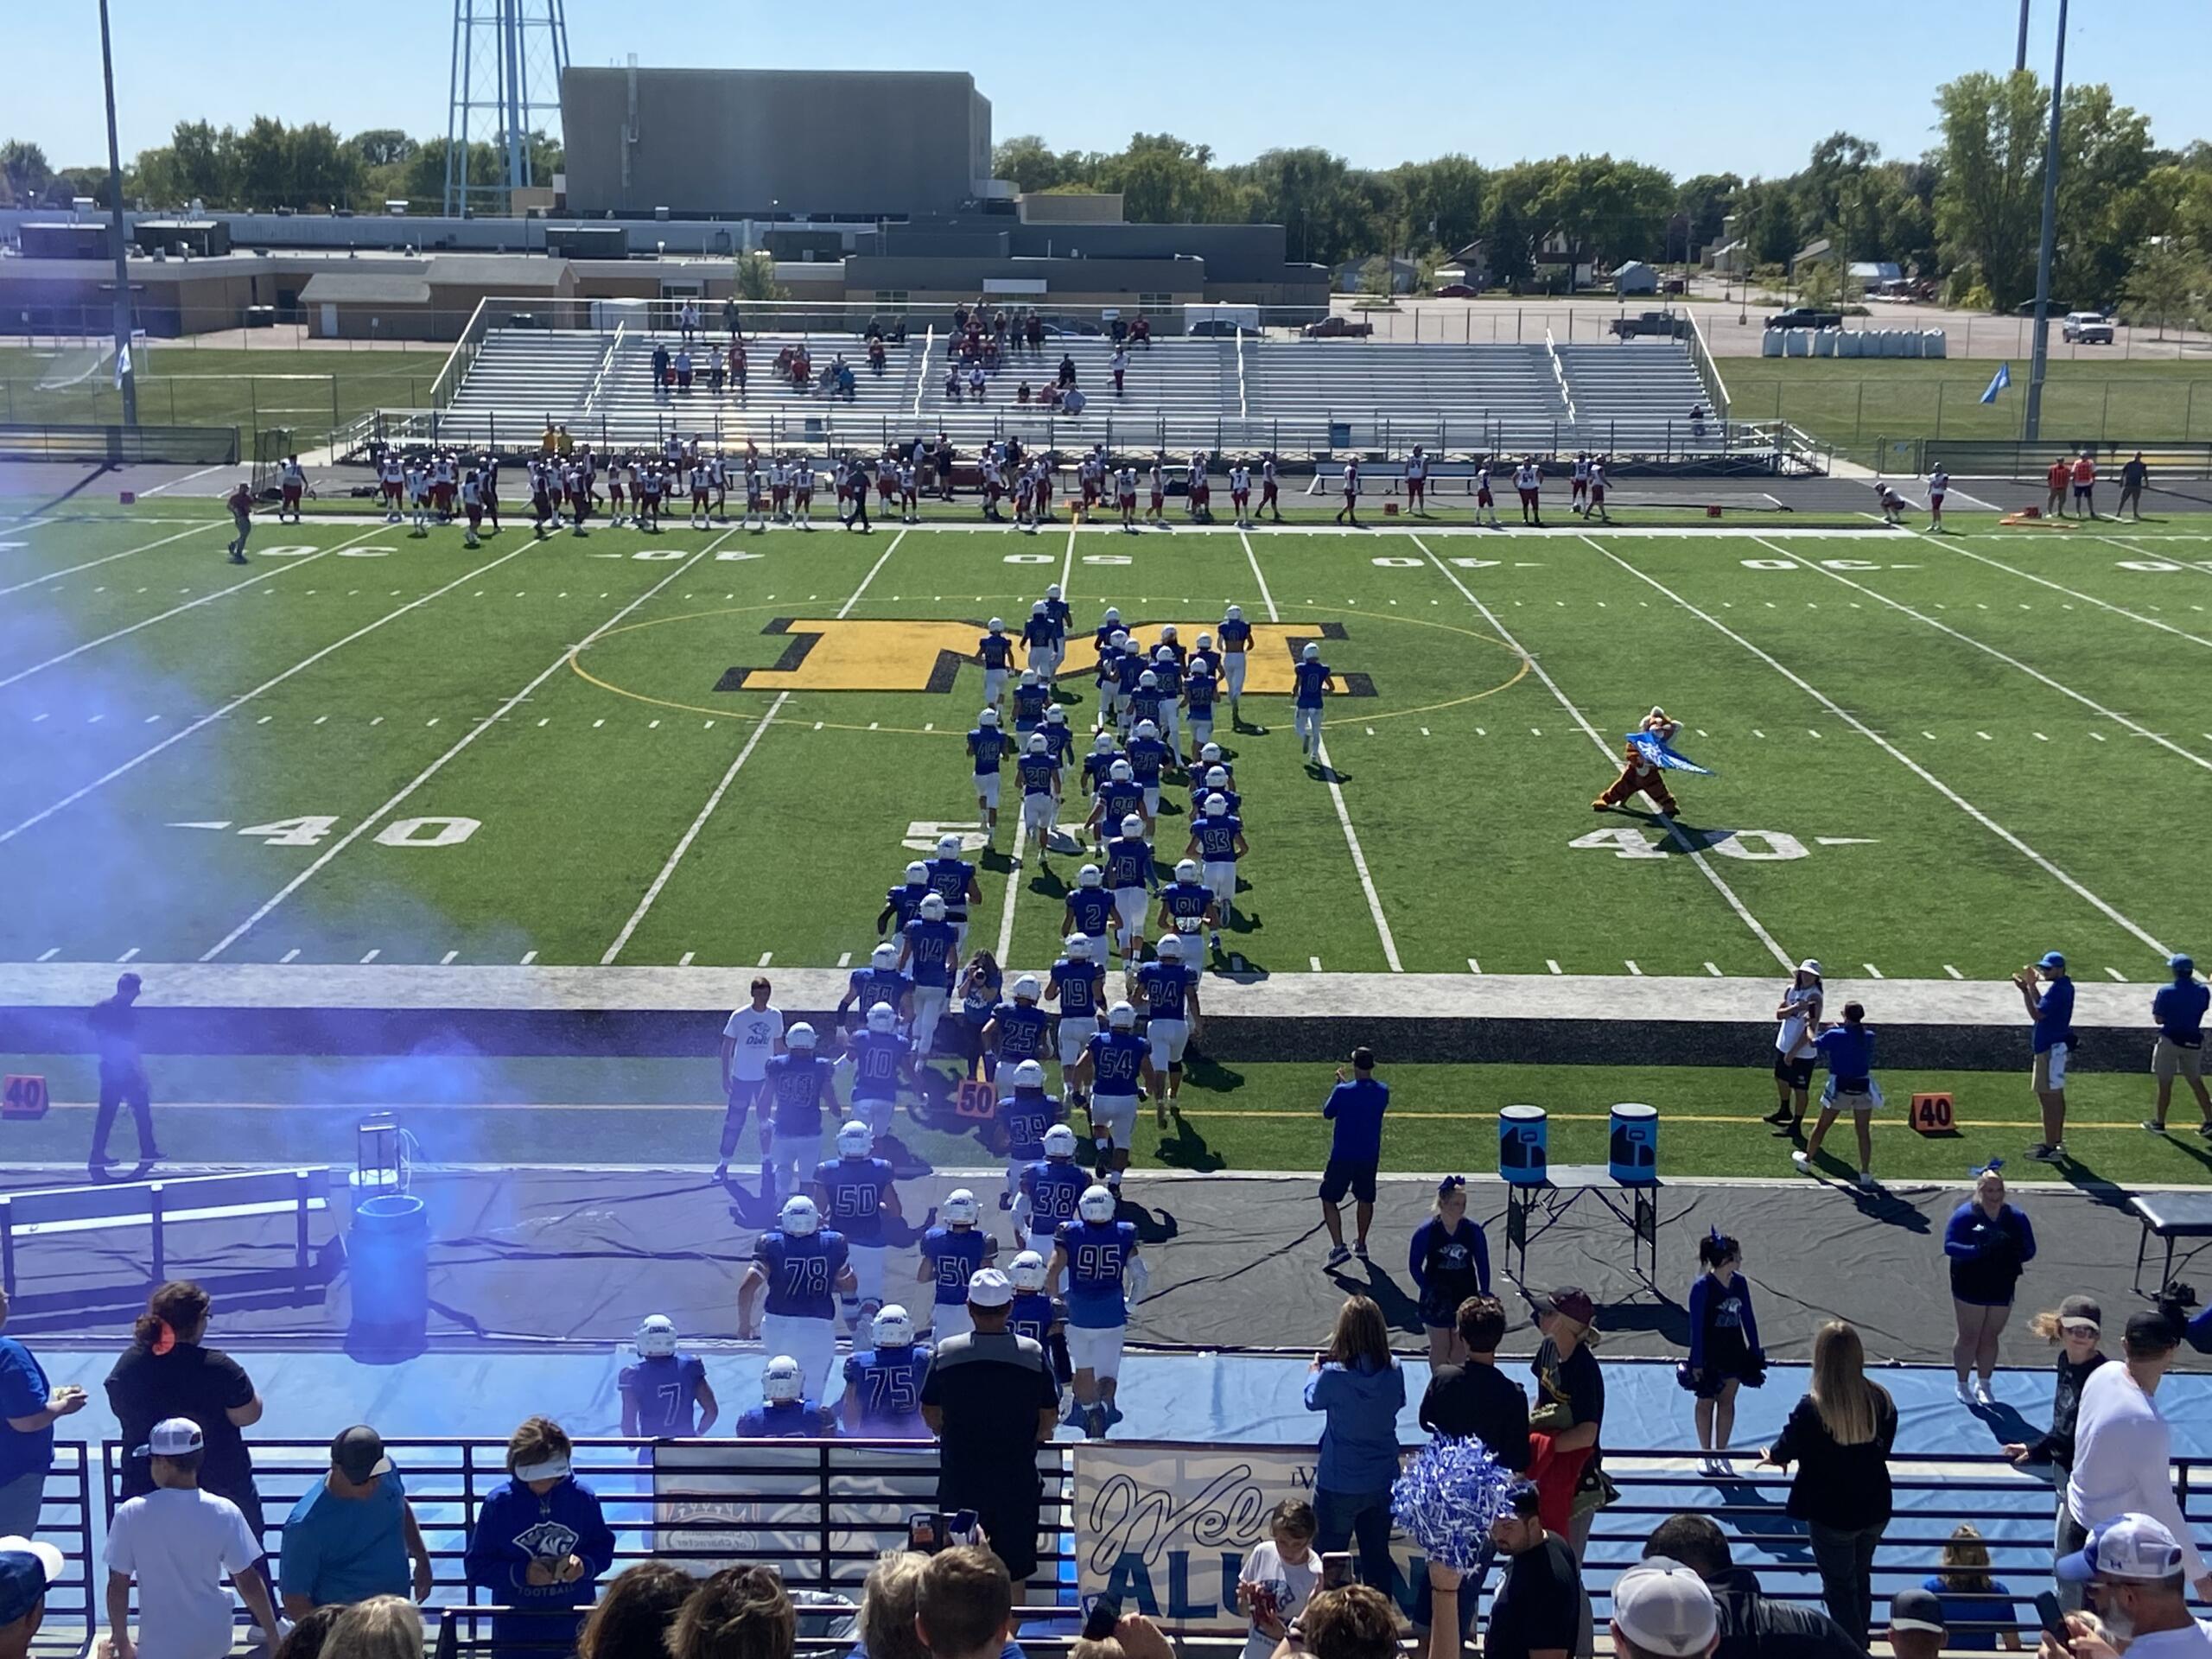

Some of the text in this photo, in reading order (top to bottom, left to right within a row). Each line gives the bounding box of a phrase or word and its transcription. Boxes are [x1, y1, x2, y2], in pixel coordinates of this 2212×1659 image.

[238, 816, 482, 847] 40
[1202, 828, 1230, 854] 93
[1085, 904, 1101, 929] 2
[919, 938, 944, 963] 14
[1061, 978, 1087, 1007] 19
[1003, 1019, 1038, 1053] 25
[865, 1047, 893, 1079] 10
[1097, 1046, 1133, 1080] 54
[5, 1080, 41, 1108] 40
[960, 1084, 992, 1113] 50
[1919, 1097, 1951, 1127] 40
[835, 1183, 879, 1217] 50
[1036, 1181, 1077, 1219] 38
[784, 1255, 829, 1299] 78
[1077, 1243, 1122, 1281] 95
[657, 1382, 681, 1427] 7
[864, 1365, 918, 1414] 75
